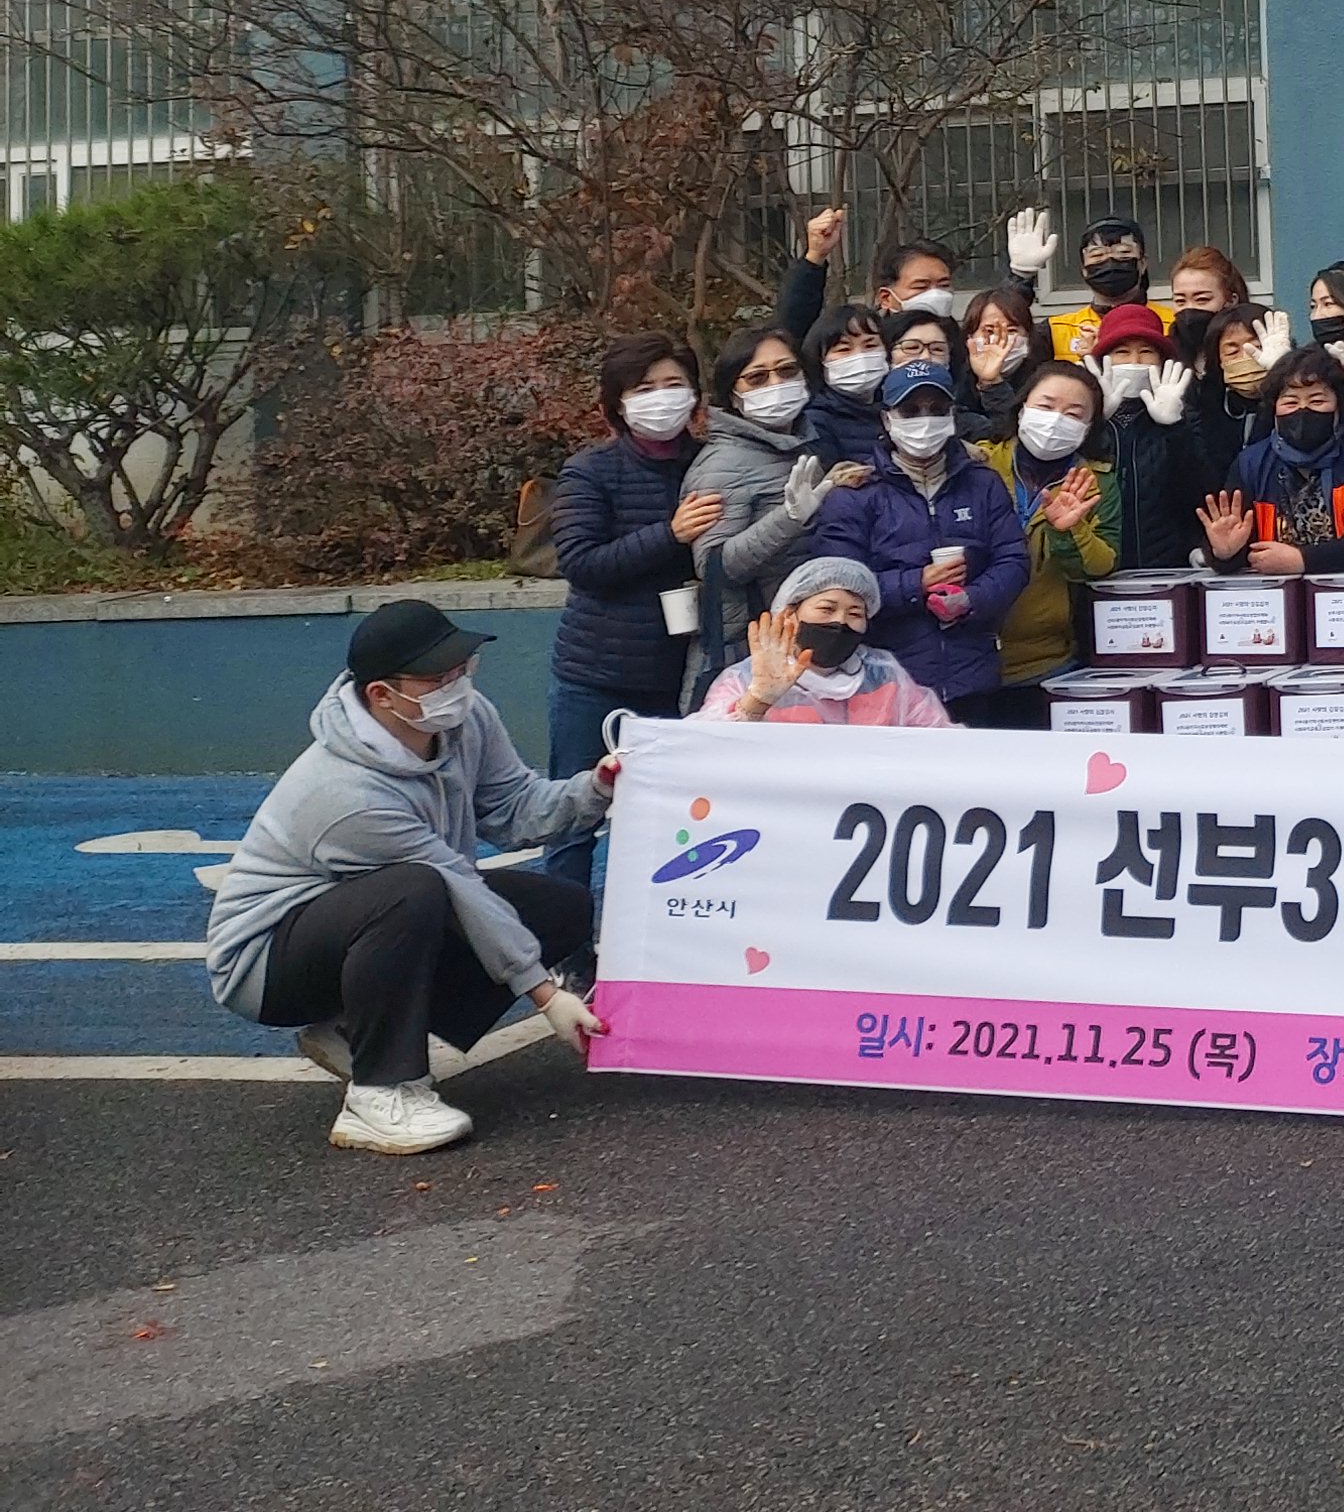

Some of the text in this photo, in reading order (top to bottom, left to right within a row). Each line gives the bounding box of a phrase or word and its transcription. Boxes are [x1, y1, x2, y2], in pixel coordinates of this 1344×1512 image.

[826, 802, 1056, 930] 2021
[665, 896, 738, 920] 안산시
[855, 1012, 936, 1059] 일시:
[948, 1020, 1173, 1072] 2021.11.25
[1186, 1030, 1256, 1083] (목)
